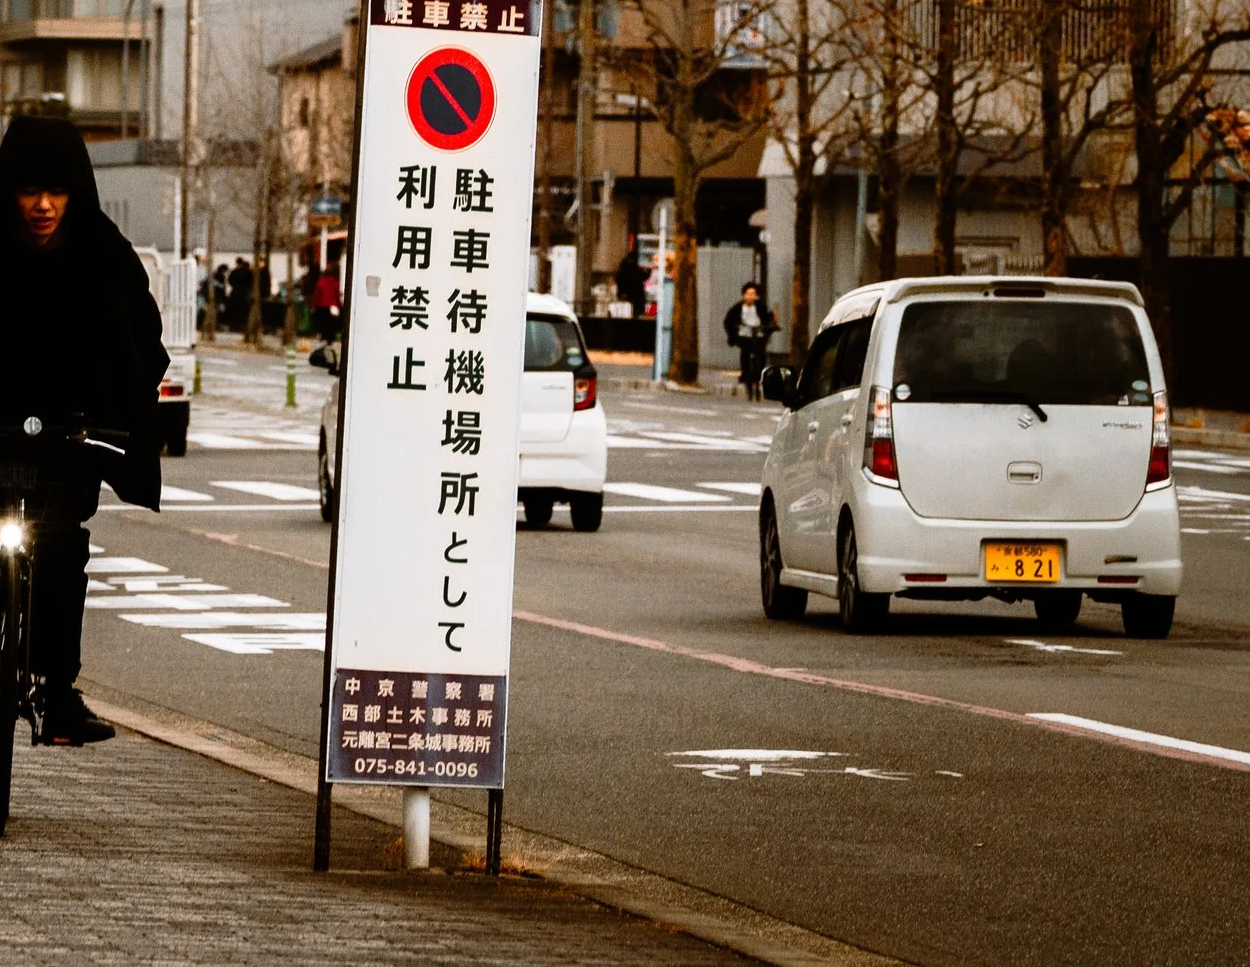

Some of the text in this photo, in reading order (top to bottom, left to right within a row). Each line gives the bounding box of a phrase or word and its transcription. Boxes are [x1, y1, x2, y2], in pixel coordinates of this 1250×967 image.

[386, 163, 436, 392] 利用禁止
[436, 167, 495, 655] 駐車待機場所として
[345, 677, 495, 702] 中京警察署
[342, 703, 494, 728] 西部土木事務所
[342, 730, 491, 754] 元離宮二条城事務所
[354, 757, 479, 778] 075-841-0096
